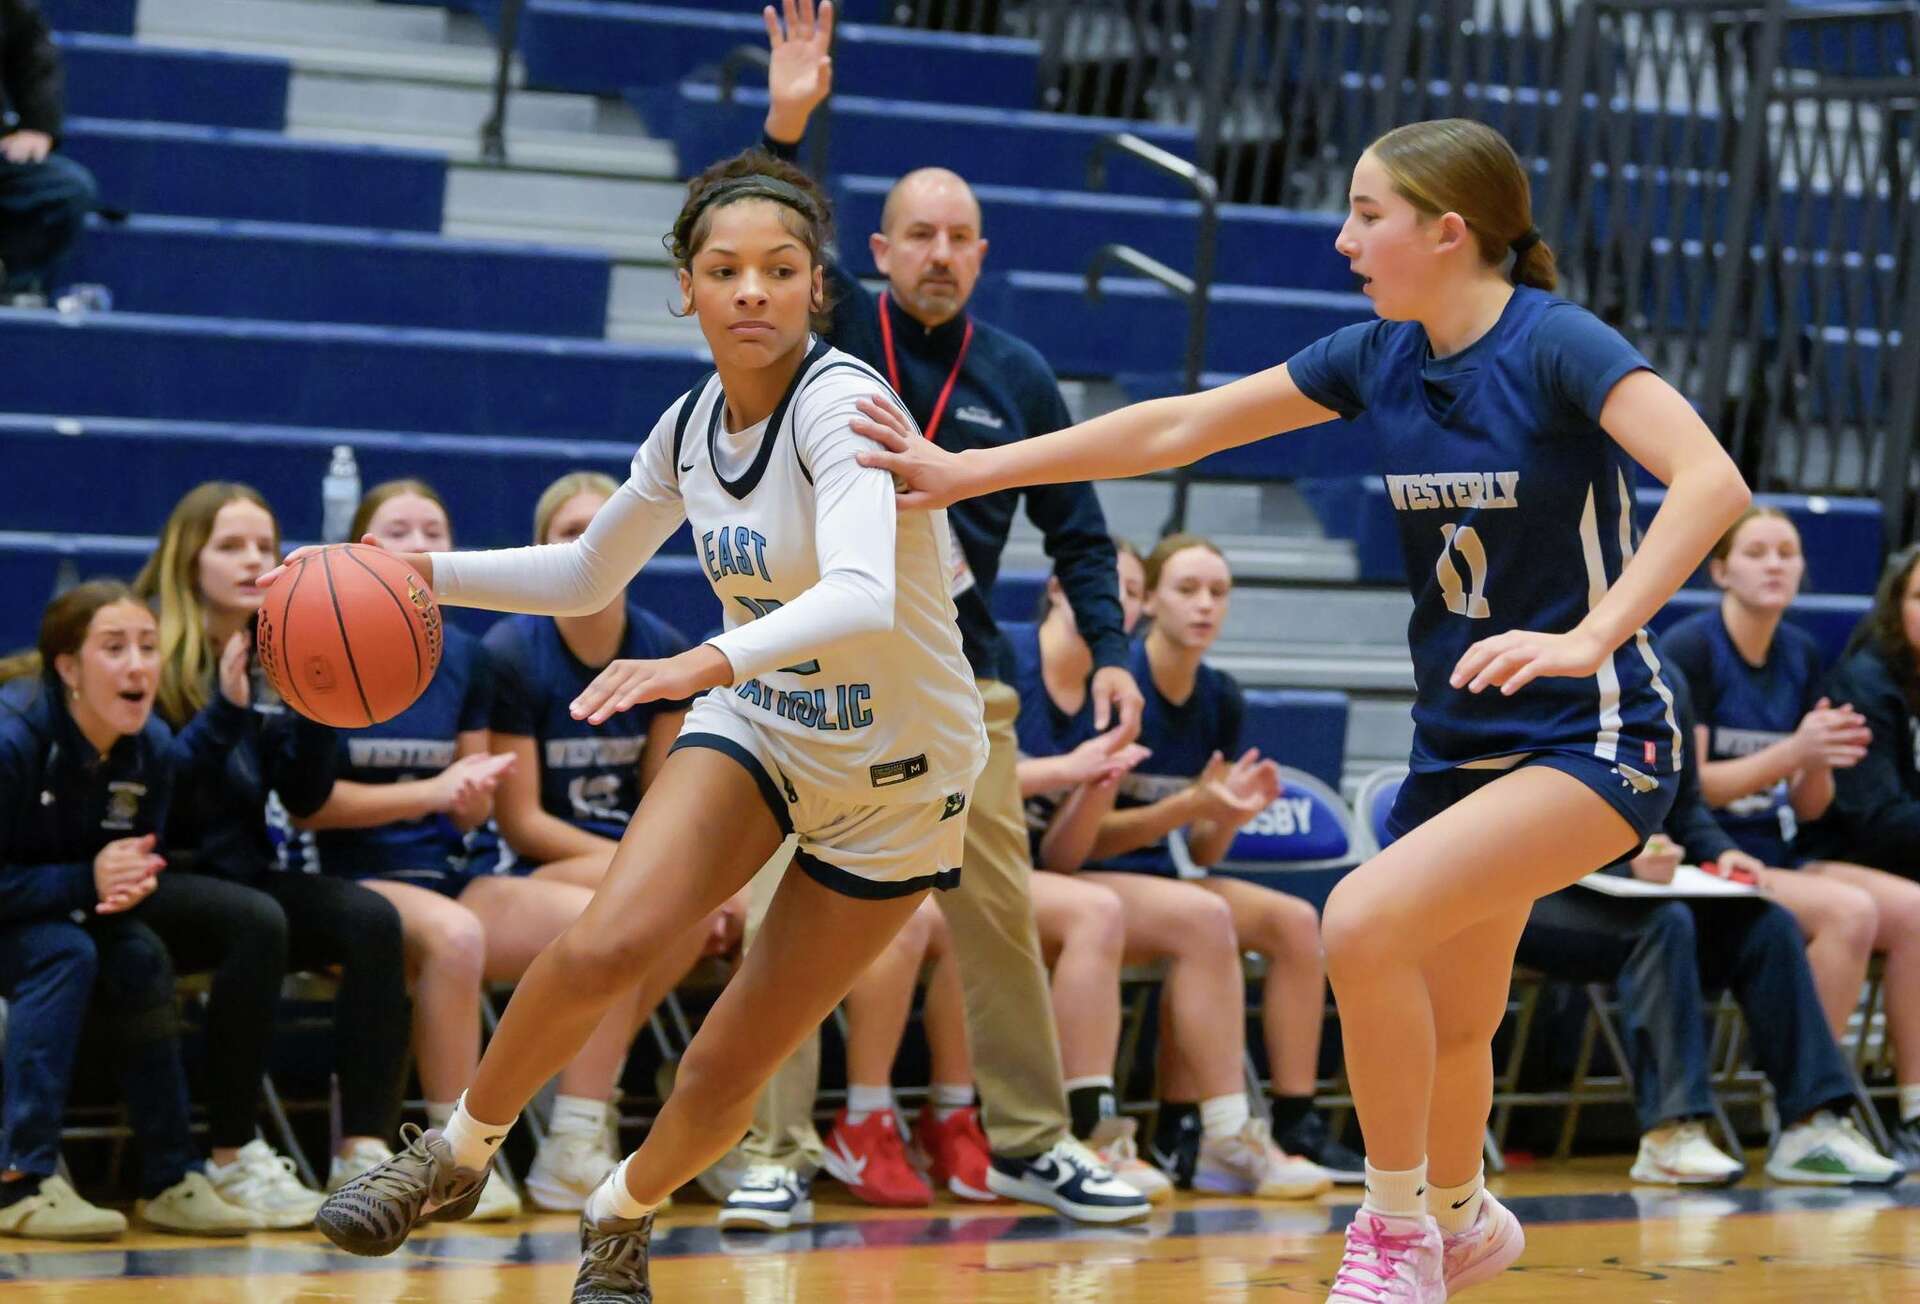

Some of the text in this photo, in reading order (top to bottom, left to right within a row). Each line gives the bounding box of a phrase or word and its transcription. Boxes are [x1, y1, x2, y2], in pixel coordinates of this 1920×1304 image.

[1385, 471, 1519, 510] WESTERLY
[702, 526, 772, 582] EAST
[735, 678, 874, 731] ATHOLIC
[910, 763, 921, 774] M
